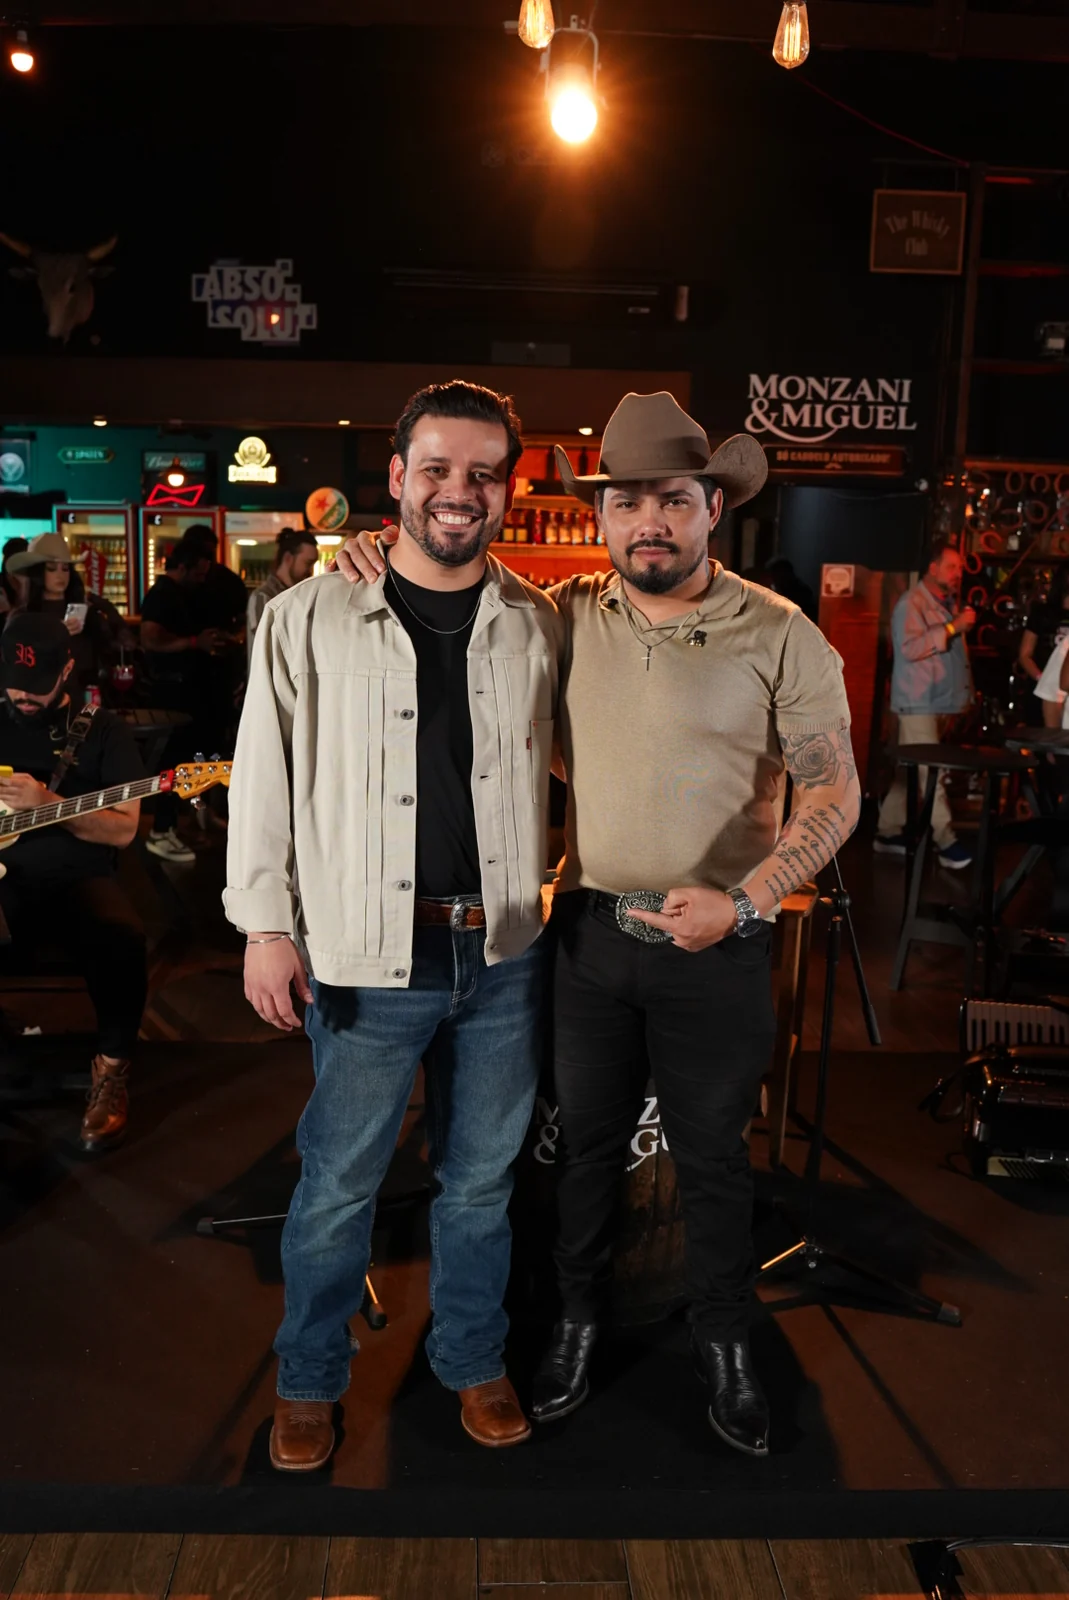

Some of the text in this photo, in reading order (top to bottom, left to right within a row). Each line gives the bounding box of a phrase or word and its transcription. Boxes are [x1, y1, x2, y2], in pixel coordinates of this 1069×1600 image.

[884, 214, 908, 234] The
[747, 373, 912, 403] MONZANI
[781, 403, 917, 430] MIGUEL
